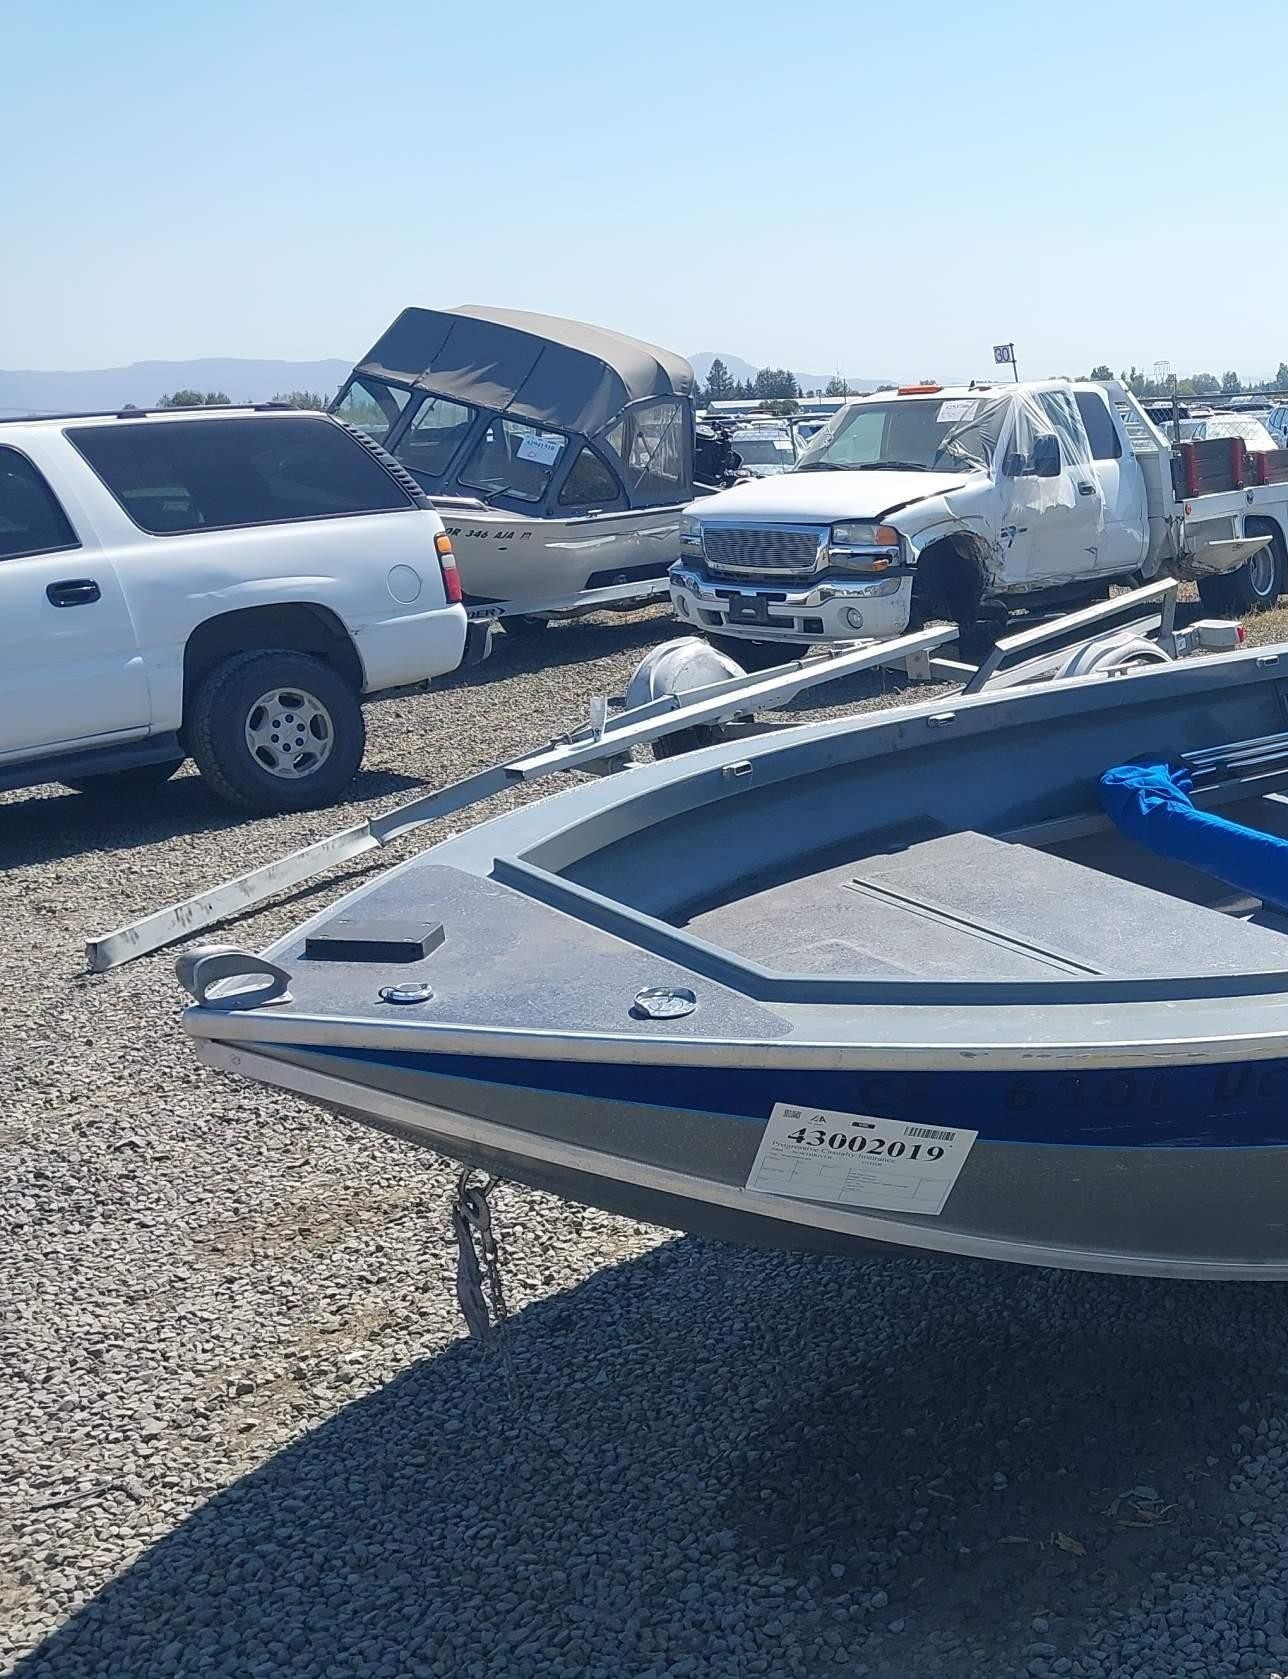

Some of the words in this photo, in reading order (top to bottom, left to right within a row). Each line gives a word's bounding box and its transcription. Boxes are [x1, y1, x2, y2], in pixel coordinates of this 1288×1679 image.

[994, 347, 1010, 362] 30
[465, 529, 489, 539] 346
[771, 1140, 819, 1153] Progressive
[821, 1147, 855, 1159] Casualty
[858, 1153, 896, 1164] Insurance
[787, 1127, 945, 1162] 43002019
